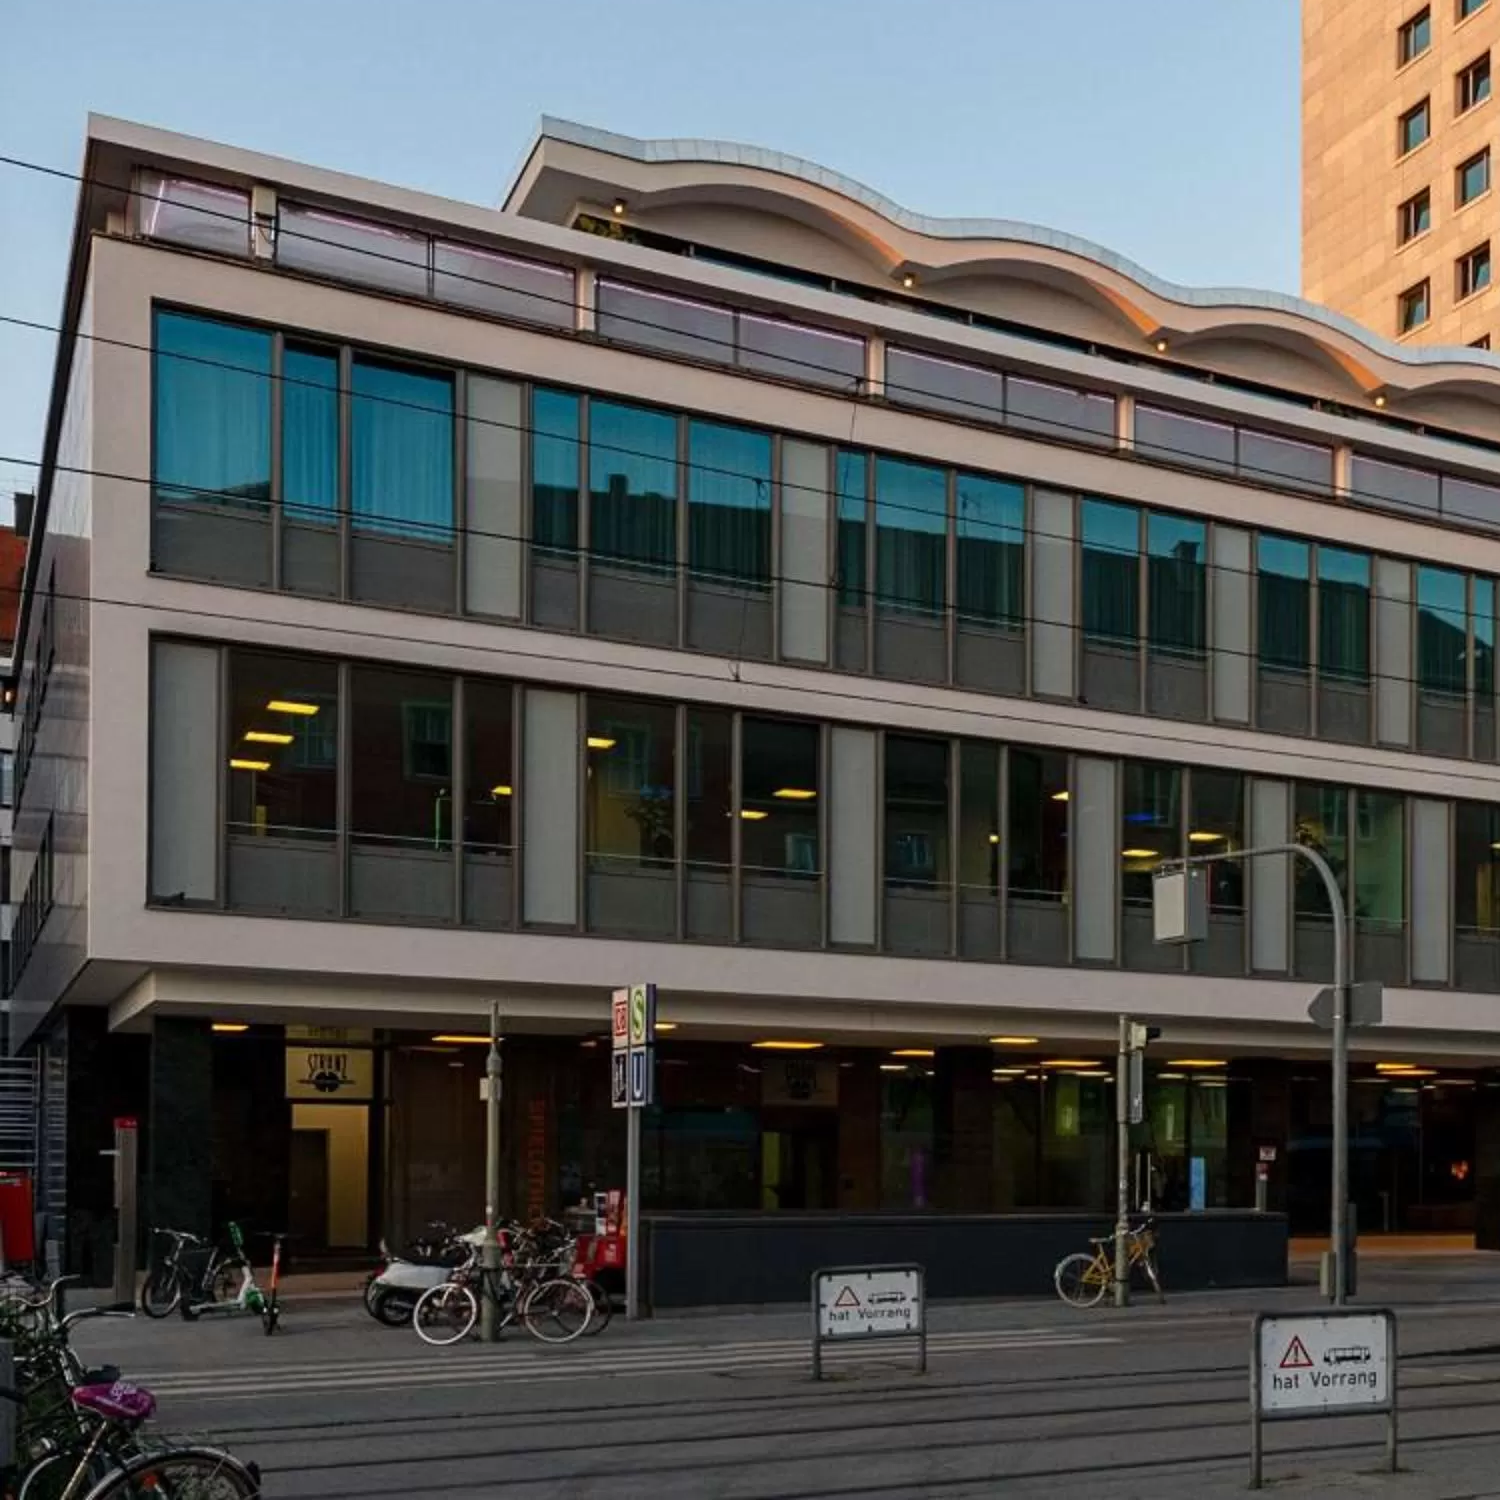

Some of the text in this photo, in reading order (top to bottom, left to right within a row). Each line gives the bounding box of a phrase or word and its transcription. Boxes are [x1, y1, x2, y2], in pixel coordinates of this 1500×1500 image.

[631, 988, 645, 1041] S
[632, 1054, 645, 1100] U
[829, 1307, 911, 1321] hat Vorrang
[1272, 1370, 1377, 1390] hat Vorrang
